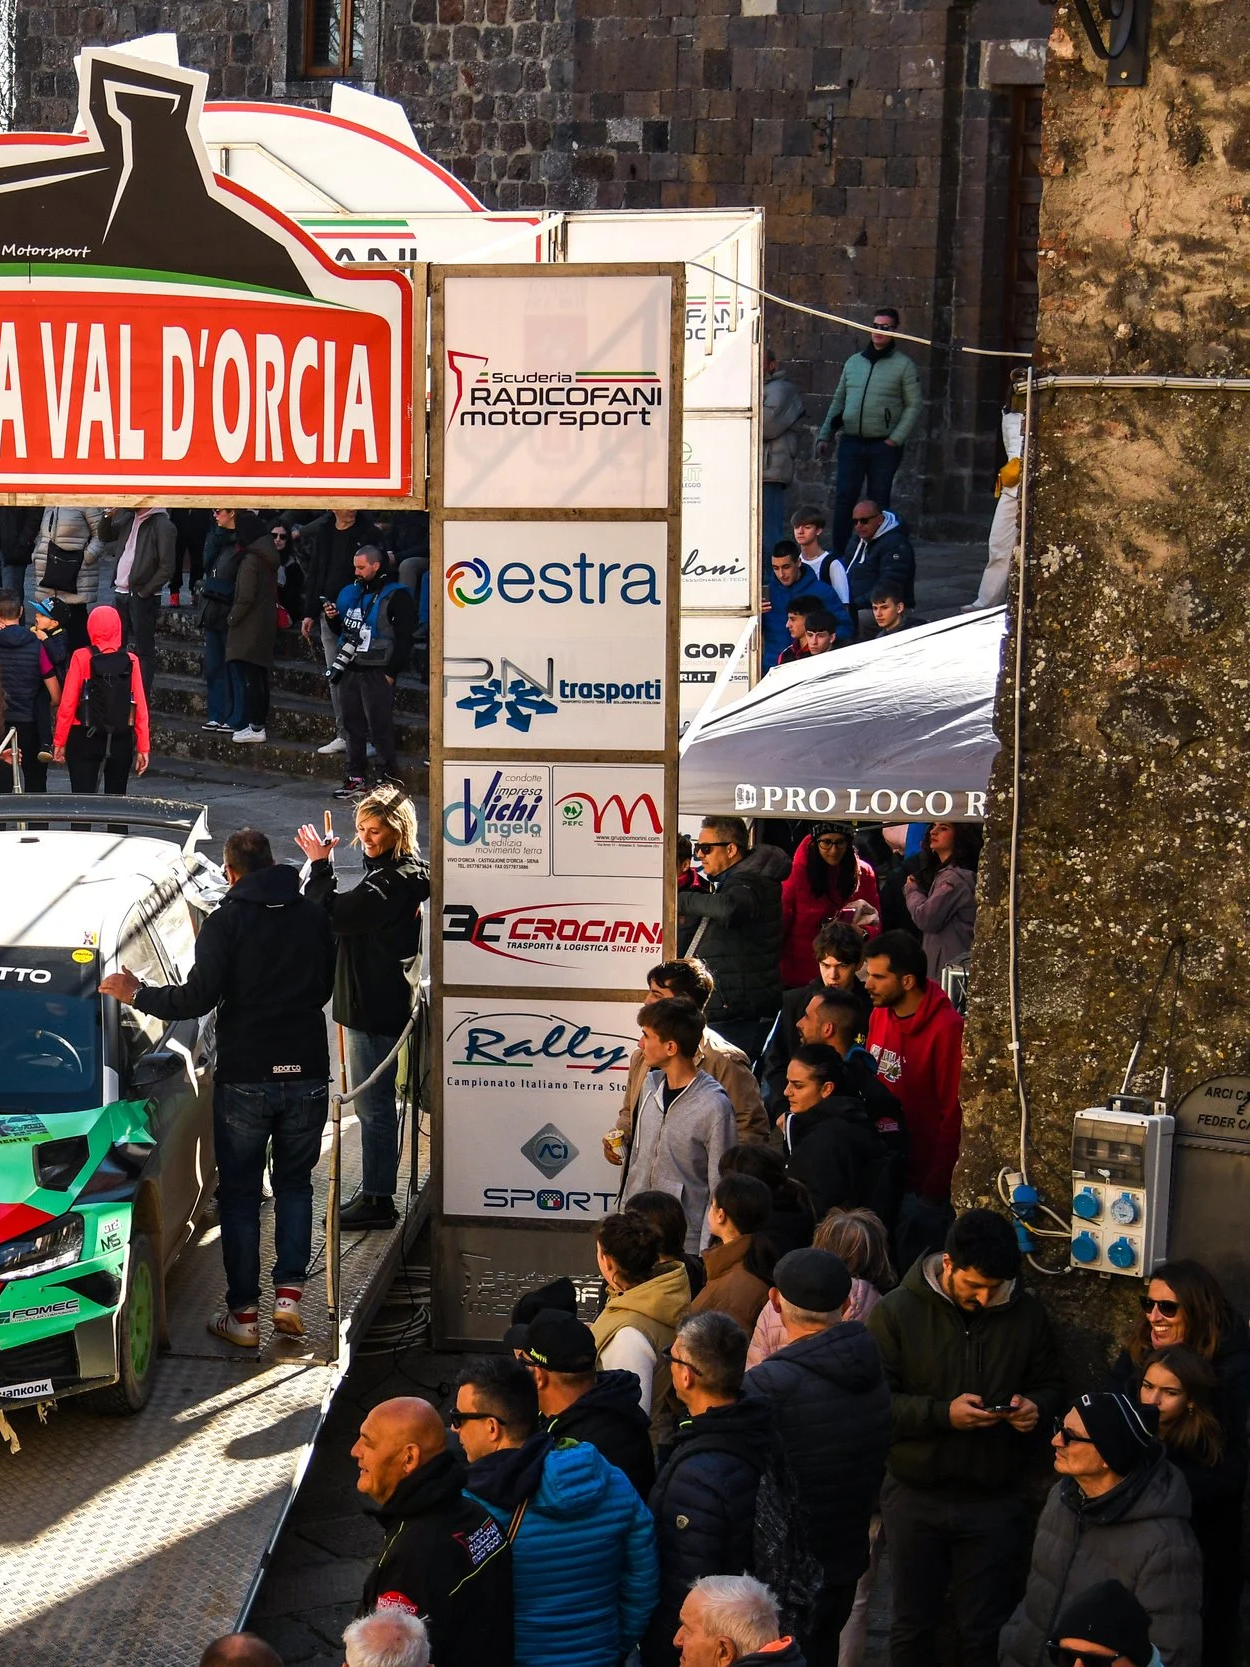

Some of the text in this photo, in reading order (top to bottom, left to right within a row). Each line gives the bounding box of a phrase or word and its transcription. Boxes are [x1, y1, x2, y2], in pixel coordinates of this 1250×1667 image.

[2, 244, 91, 258] Motorsport
[492, 372, 572, 383] Scuderia
[40, 322, 144, 460] VAL
[161, 325, 378, 464] D'ORCIA
[471, 387, 662, 406] RADICOFANI
[460, 407, 651, 431] motorsport
[497, 553, 661, 605] estra
[559, 679, 661, 703] trasporti
[505, 772, 542, 782] condotte
[495, 786, 543, 798] impresa
[761, 786, 836, 813] PRO
[845, 788, 953, 816] LOCO
[491, 839, 522, 847] edilizia
[507, 941, 553, 950] TRASPORTI
[564, 944, 609, 952] LOGISTICA
[611, 945, 637, 953] SINCE
[465, 1025, 629, 1074] Rally
[273, 1063, 301, 1073] sparco
[447, 1077, 626, 1092] Campionato Italiano Terra Sto
[1205, 1087, 1233, 1099] ARCI
[1237, 1105, 1245, 1115] E
[1197, 1114, 1235, 1128] FEDER
[539, 1143, 568, 1159] ACI
[483, 1188, 618, 1212] SPORT
[12, 1299, 78, 1318] FOMEC
